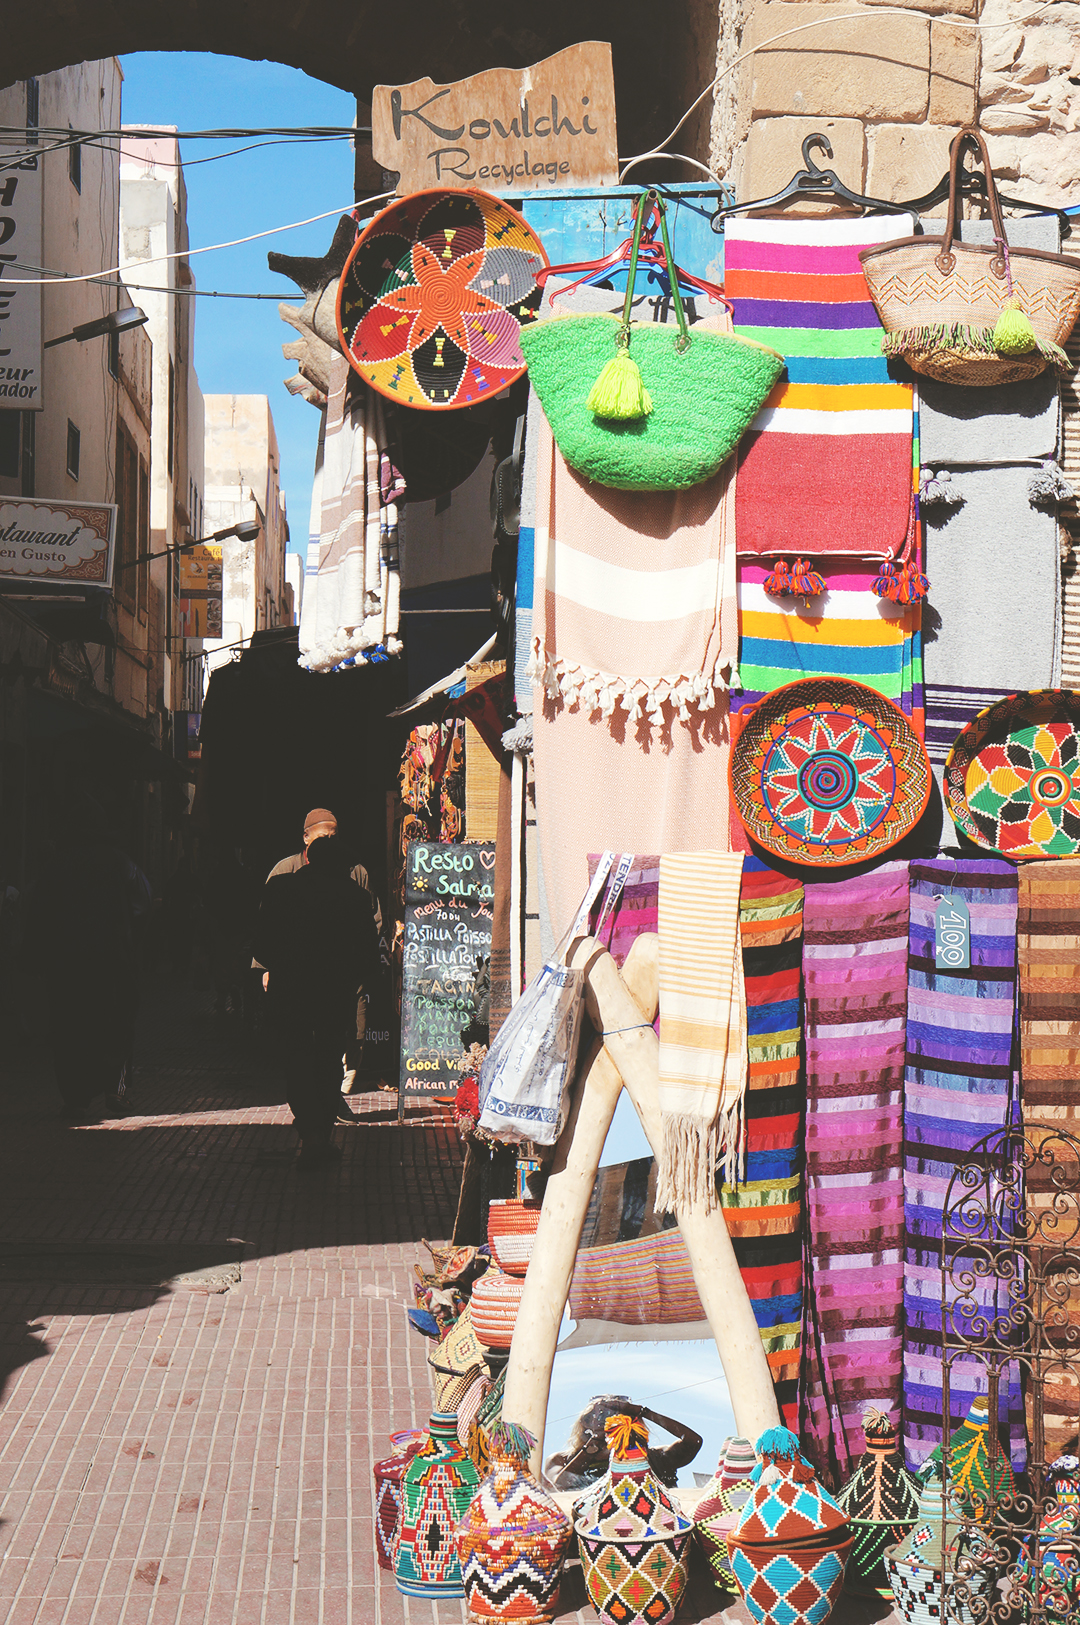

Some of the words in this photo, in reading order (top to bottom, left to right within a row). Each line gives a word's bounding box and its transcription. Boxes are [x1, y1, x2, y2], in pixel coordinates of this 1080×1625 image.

[391, 88, 597, 141] Koulchi
[427, 147, 570, 185] Recyclage
[21, 547, 66, 562] Gusto
[412, 847, 474, 873] Resto
[436, 874, 496, 898] Salma
[448, 897, 468, 909] du
[939, 910, 967, 966] 100
[365, 1027, 390, 1044] tique
[406, 1058, 440, 1072] Good
[404, 1077, 447, 1091] African
